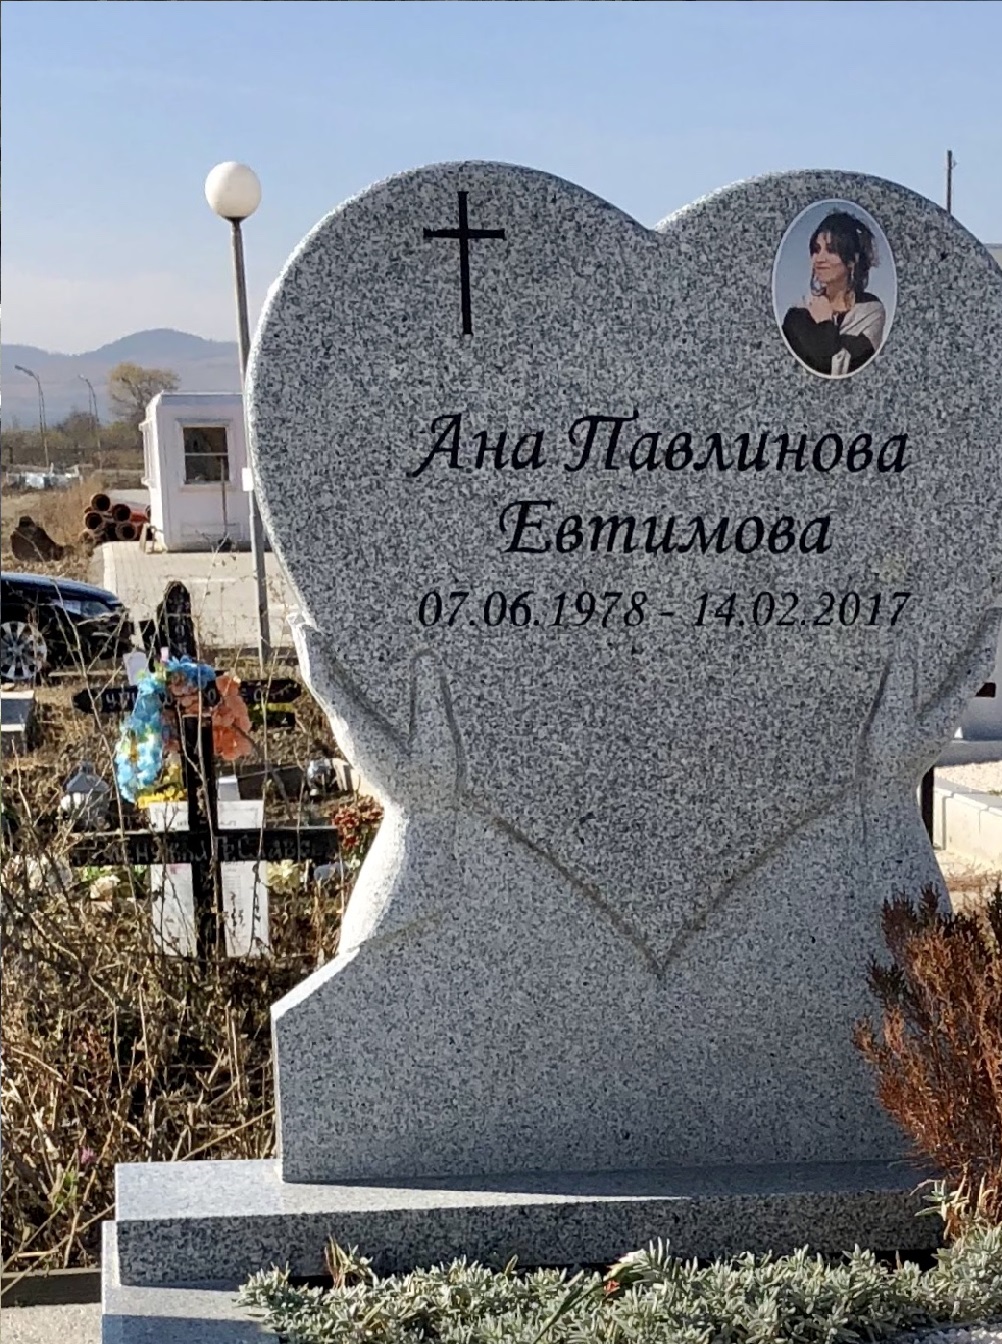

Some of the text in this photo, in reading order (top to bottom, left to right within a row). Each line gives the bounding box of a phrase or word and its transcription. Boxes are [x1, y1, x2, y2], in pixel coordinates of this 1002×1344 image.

[407, 410, 909, 478] Ана Павлинова
[499, 499, 832, 555] Евтимова
[417, 590, 649, 628] 07.06.1978
[694, 590, 912, 628] 14.02.2017
